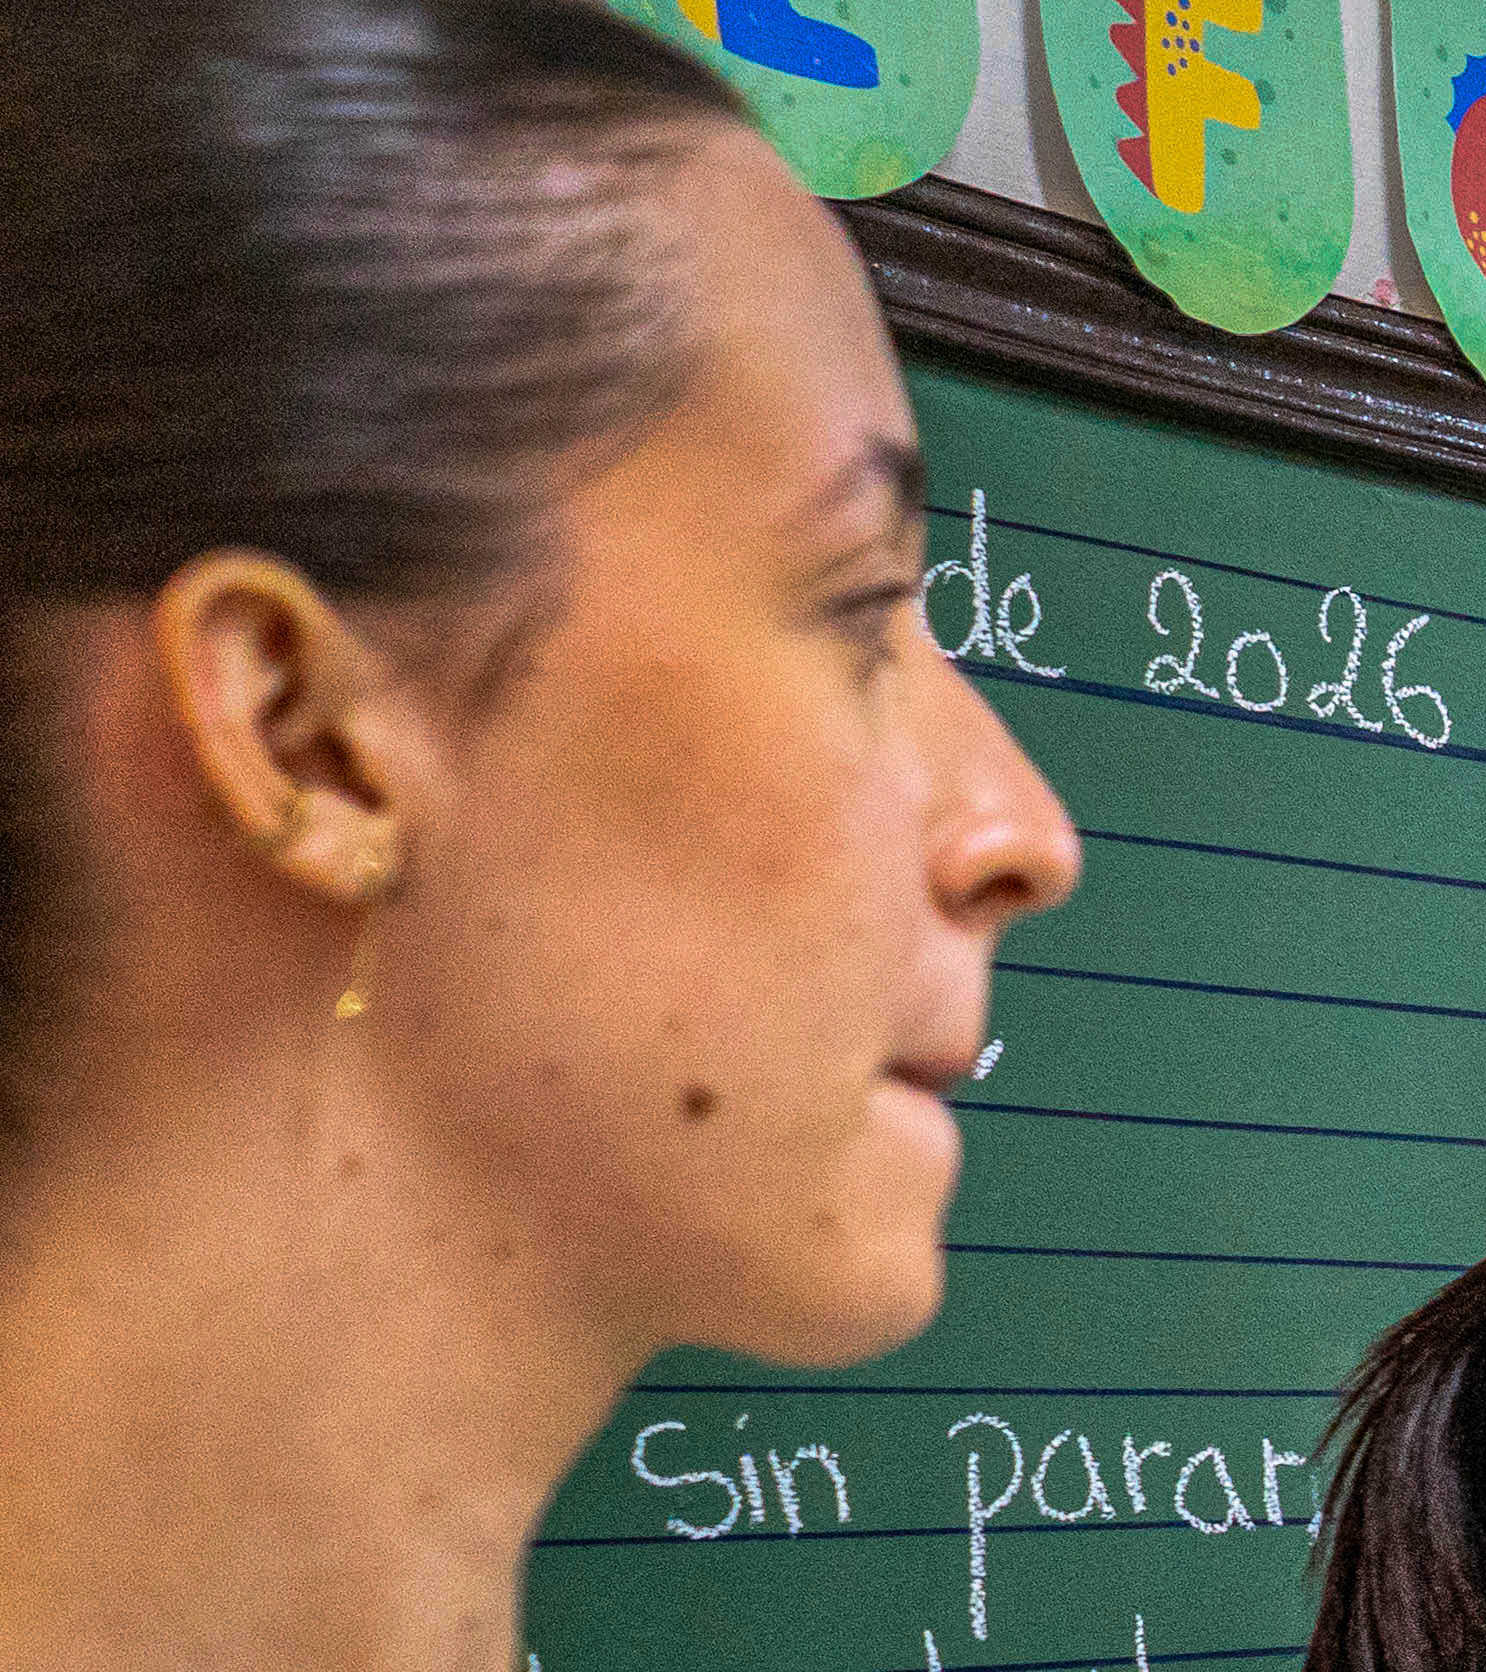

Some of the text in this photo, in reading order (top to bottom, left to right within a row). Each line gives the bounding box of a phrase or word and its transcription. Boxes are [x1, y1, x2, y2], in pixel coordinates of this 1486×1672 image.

[1146, 0, 1263, 214] F
[914, 487, 1451, 750] de 2026
